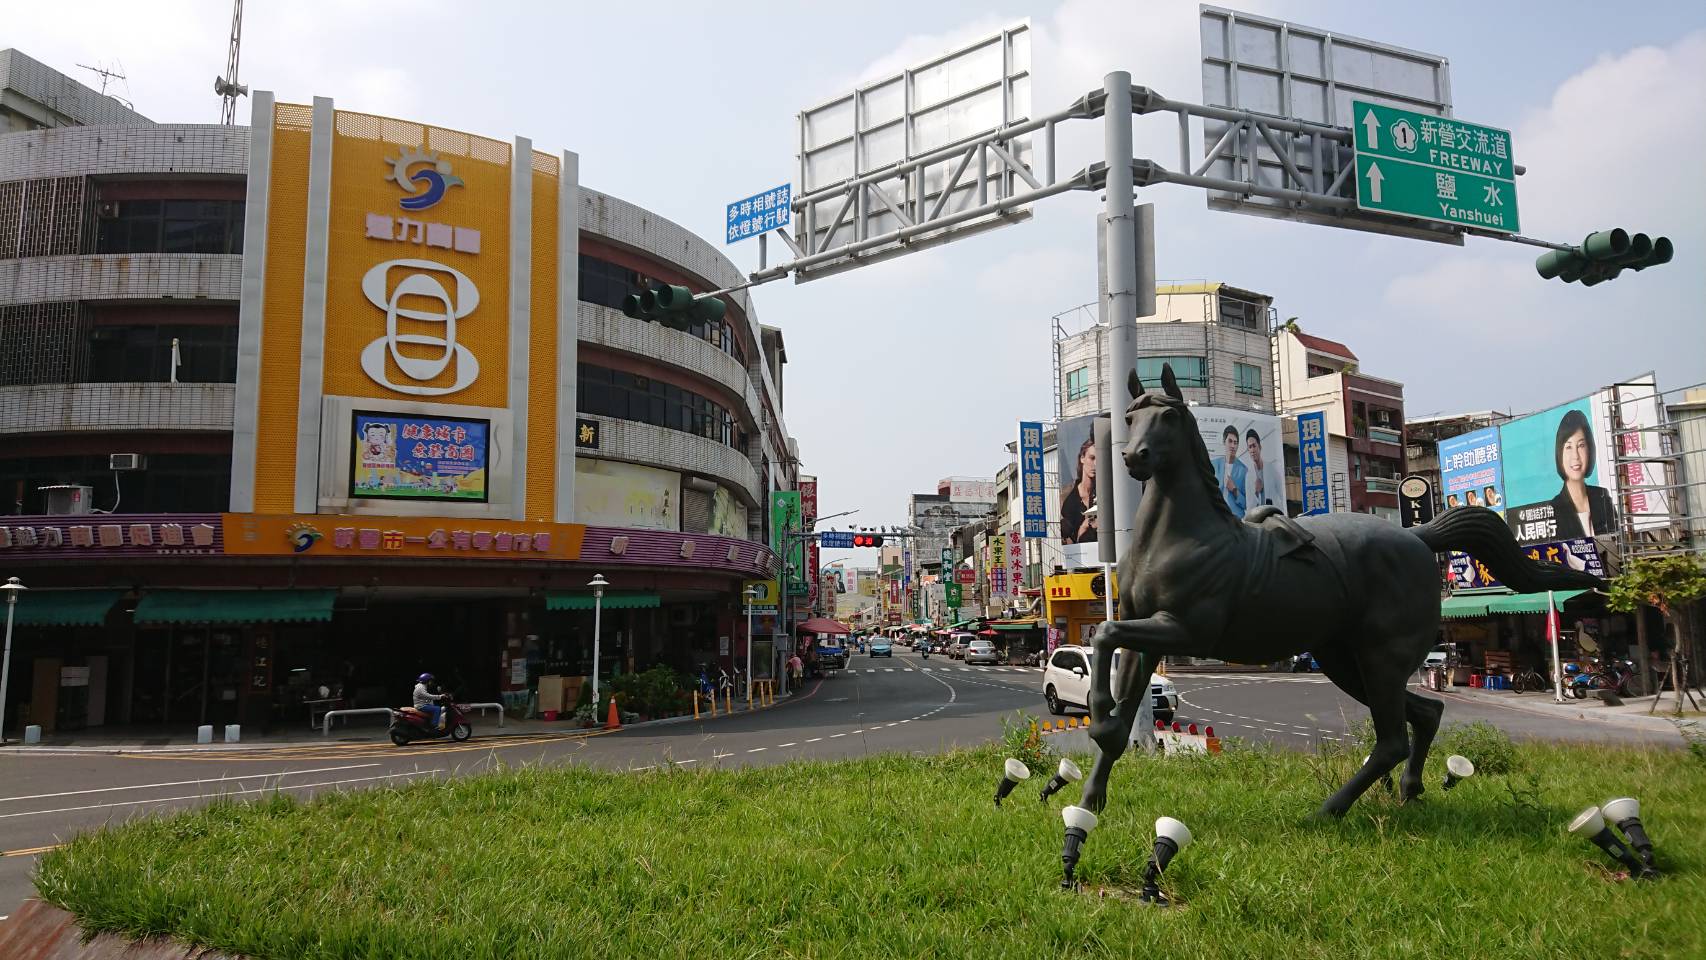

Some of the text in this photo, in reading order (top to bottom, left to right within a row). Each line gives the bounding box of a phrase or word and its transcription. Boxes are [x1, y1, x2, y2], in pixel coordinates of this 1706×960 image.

[1401, 118, 1508, 160] 1 新營交流道
[1430, 150, 1502, 175] FREEWAY
[728, 187, 789, 222] 多時相號誌
[1436, 172, 1504, 207] 鹽水
[728, 206, 788, 241] 依燈號行駛
[1440, 202, 1504, 227] Yanshuei
[579, 423, 595, 444] 新
[1023, 427, 1043, 516] 現代鐘錶
[1302, 419, 1326, 512] 現代鐘錶
[1443, 442, 1498, 473] 上聆助聽器
[1515, 519, 1558, 542] 人民同行
